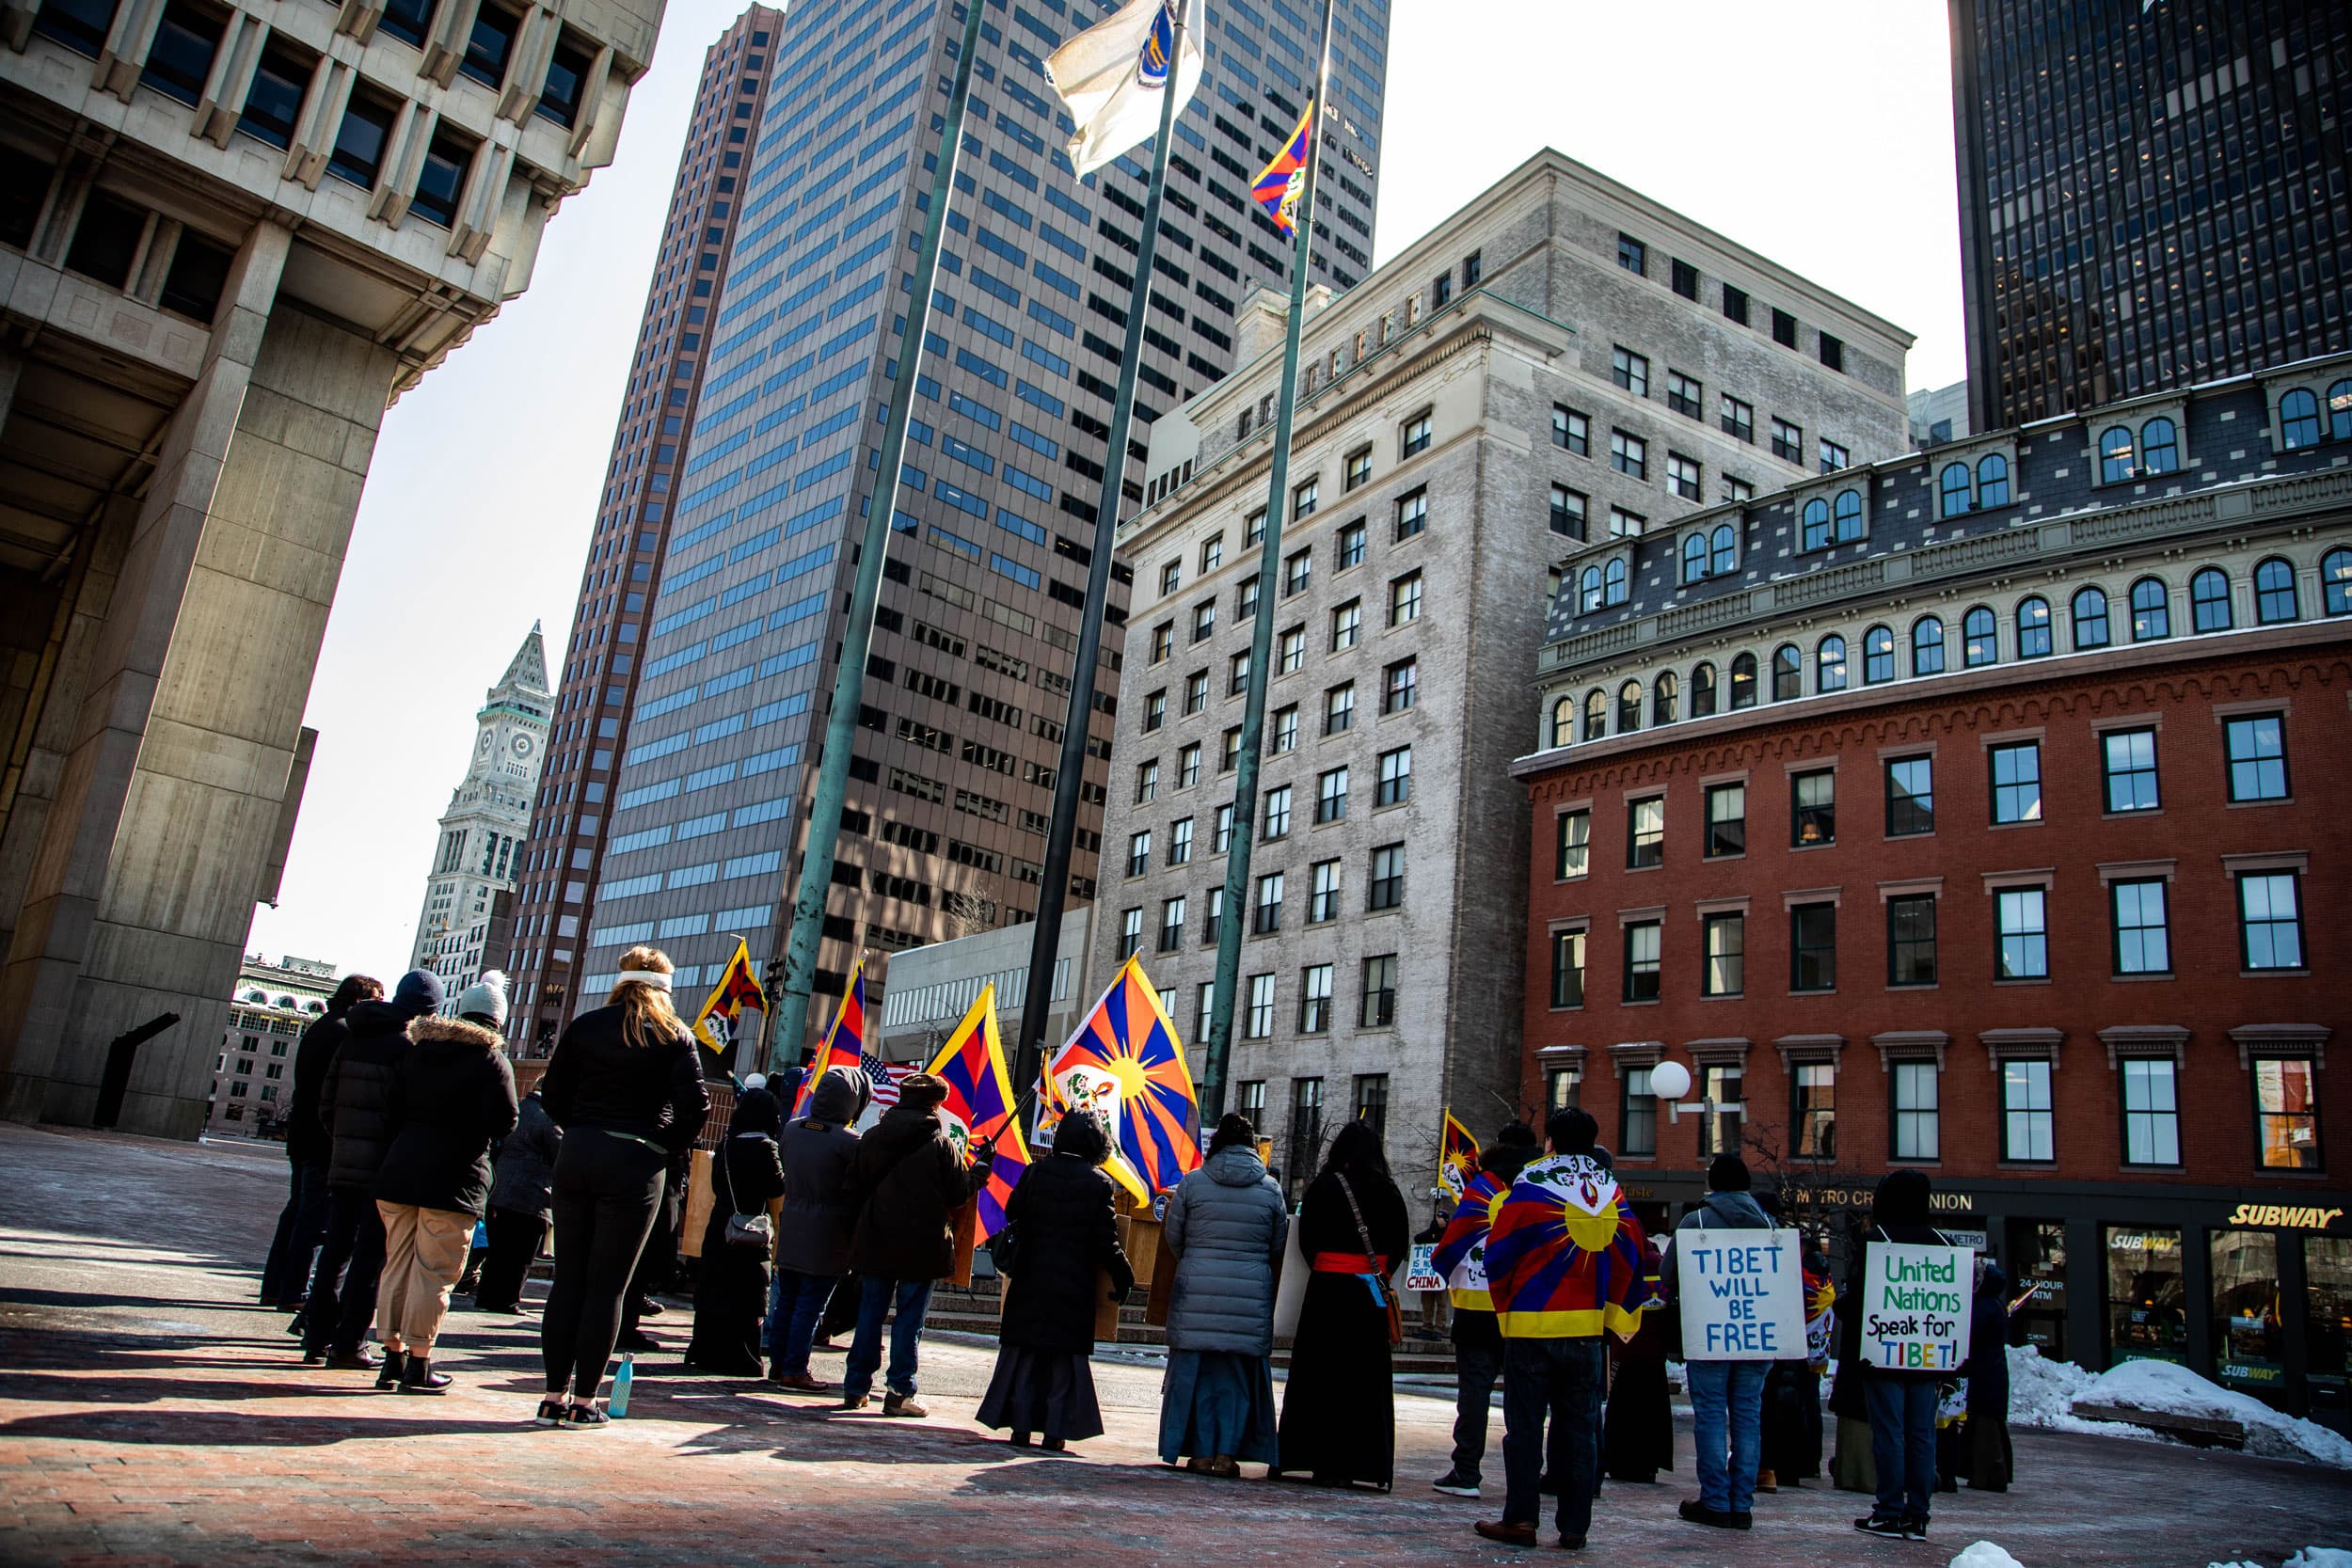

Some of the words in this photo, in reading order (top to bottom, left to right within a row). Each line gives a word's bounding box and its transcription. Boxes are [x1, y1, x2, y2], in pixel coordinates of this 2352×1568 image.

[1930, 1195, 1973, 1211] NION
[2228, 1203, 2344, 1229] SUBWAY
[1414, 1246, 1434, 1258] TIB
[2110, 1235, 2180, 1250] SUBWAY
[1692, 1246, 1784, 1275] TIBET
[1885, 1254, 1955, 1283] United
[1407, 1276, 1440, 1289] CHINA
[1709, 1277, 1770, 1298] WILL
[1883, 1286, 1962, 1313] Nations
[2031, 1291, 2052, 1300] ATM
[1729, 1299, 1756, 1320] BE
[1707, 1323, 1778, 1352] FREE
[1867, 1314, 1918, 1342] Speak
[1923, 1314, 1955, 1337] for
[1881, 1339, 1957, 1368] TIBET!
[2220, 1365, 2280, 1380] SUBWAY
